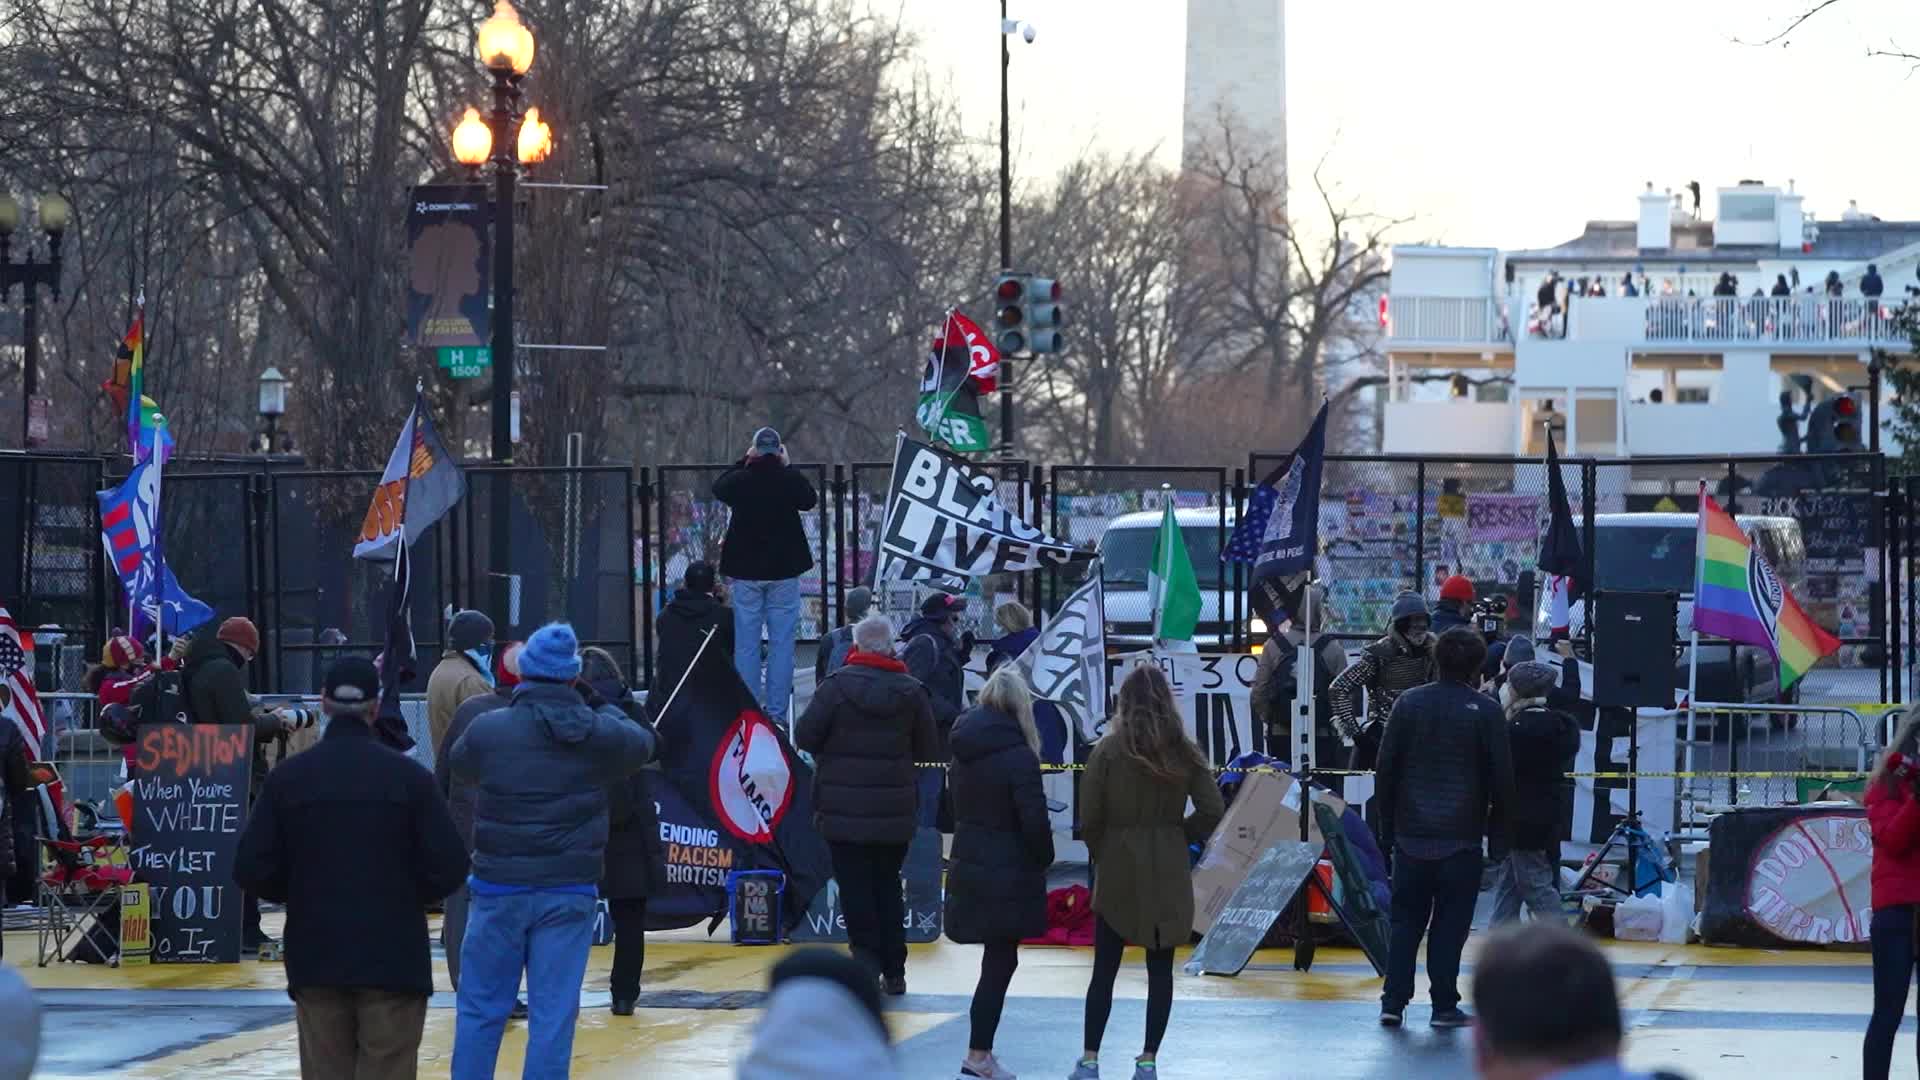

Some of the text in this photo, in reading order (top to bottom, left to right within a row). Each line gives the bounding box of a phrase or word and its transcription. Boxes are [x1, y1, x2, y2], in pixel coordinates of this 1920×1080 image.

[451, 350, 464, 365] H
[451, 366, 481, 377] 1500
[138, 776, 183, 800] When
[146, 802, 239, 833] WHITE
[659, 821, 719, 848] ENDING
[178, 847, 216, 874] LET
[667, 843, 734, 868] RACISM
[149, 885, 224, 920] YOU
